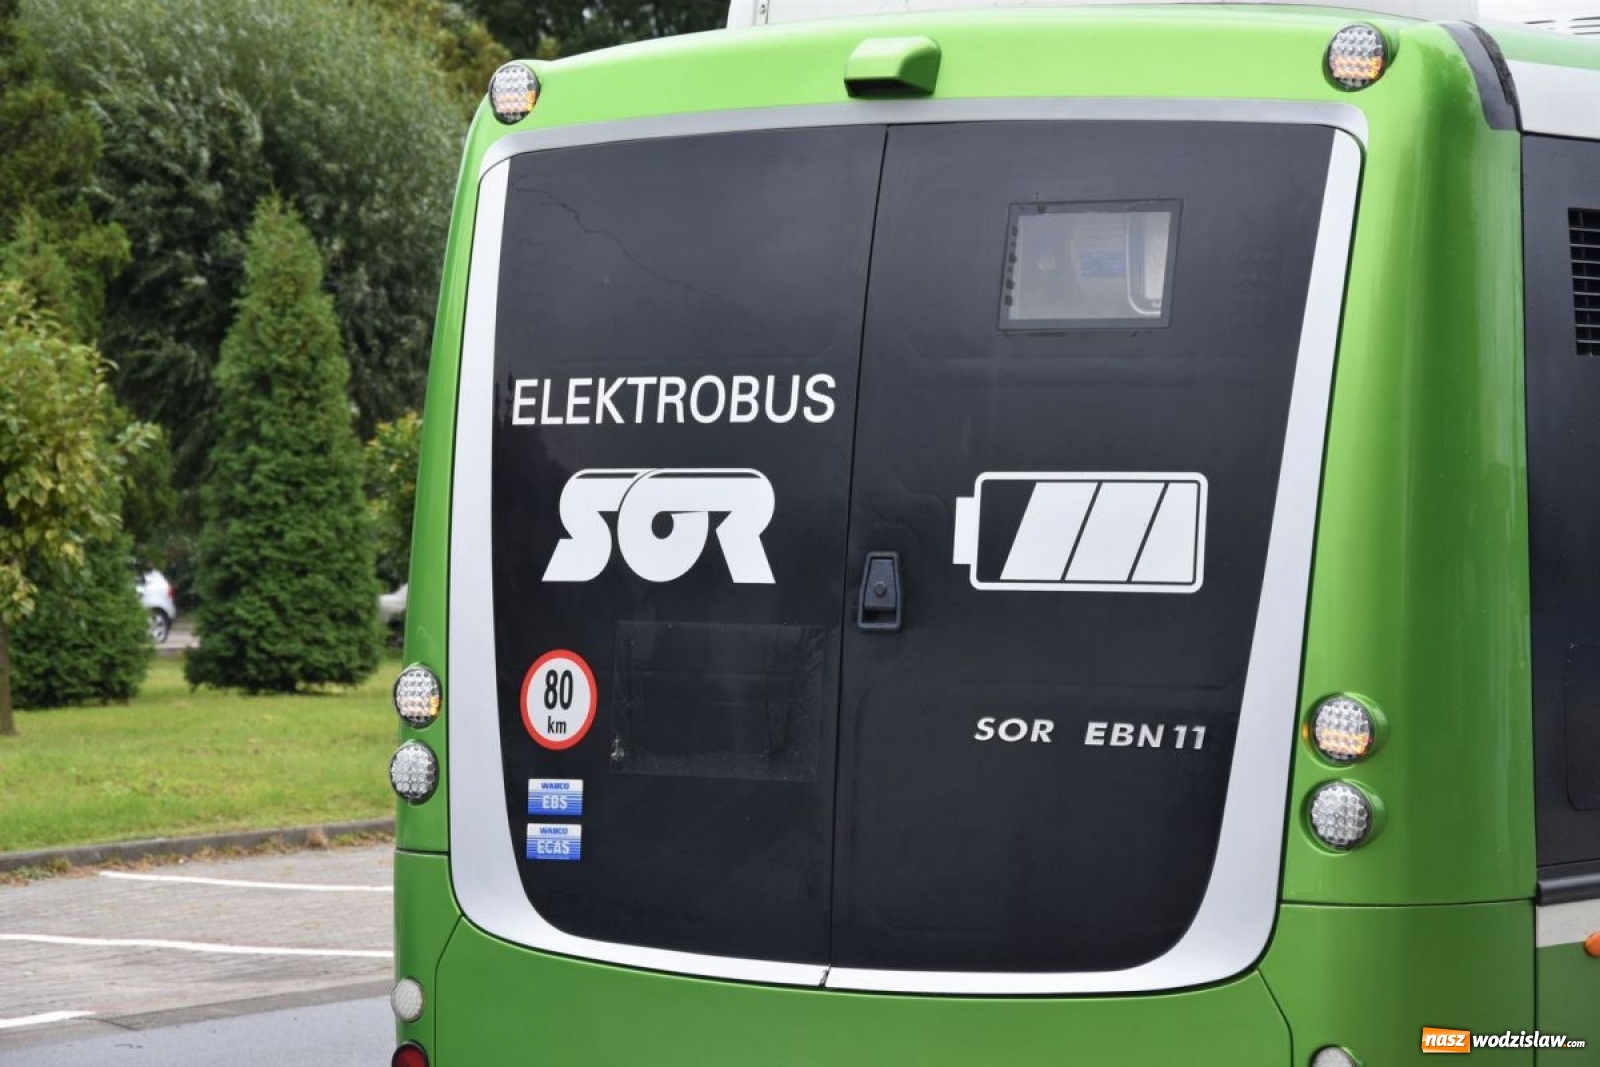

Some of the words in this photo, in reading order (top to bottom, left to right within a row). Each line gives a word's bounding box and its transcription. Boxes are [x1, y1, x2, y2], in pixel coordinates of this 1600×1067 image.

[511, 373, 836, 426] ELEKTROBUS
[541, 467, 776, 584] SOR
[544, 669, 573, 710] 80
[547, 716, 567, 734] km
[973, 716, 1054, 743] SOR
[1084, 721, 1165, 748] EBN
[1173, 725, 1206, 750] 11
[541, 782, 570, 790] WABCO
[539, 827, 568, 835] WABCO
[536, 840, 570, 855] ECAS
